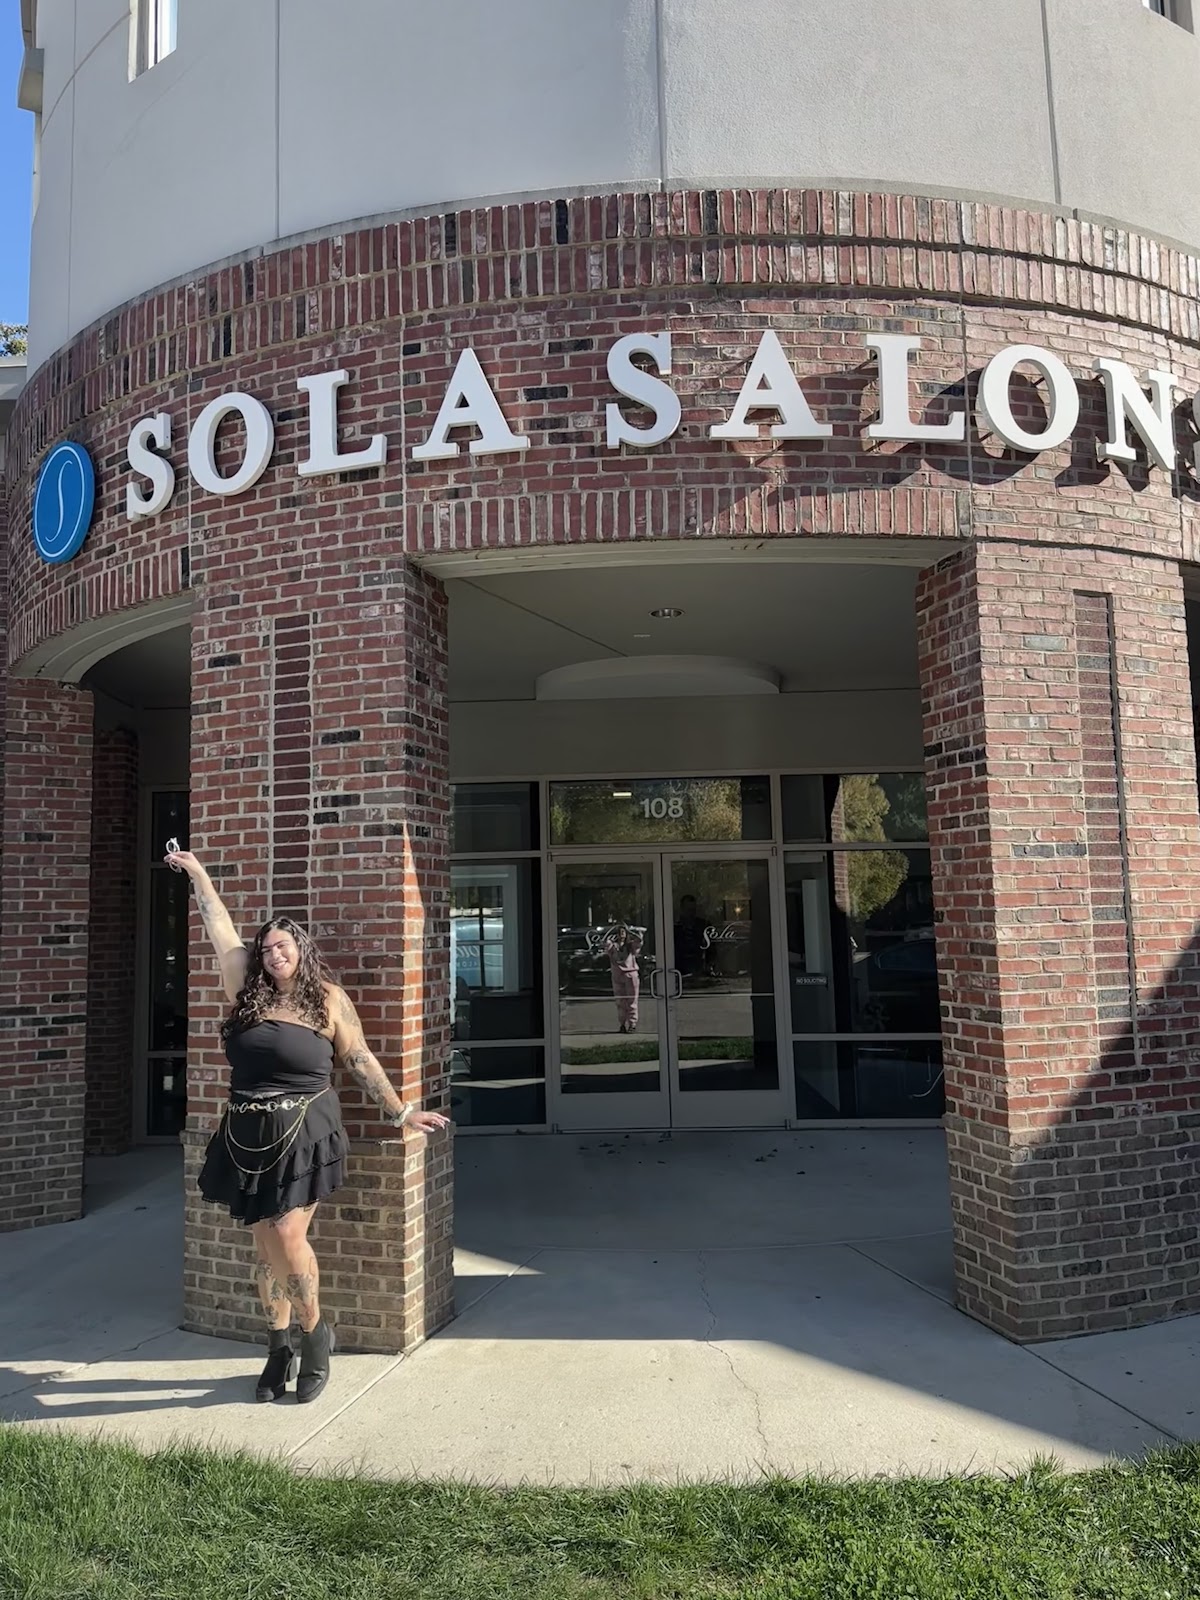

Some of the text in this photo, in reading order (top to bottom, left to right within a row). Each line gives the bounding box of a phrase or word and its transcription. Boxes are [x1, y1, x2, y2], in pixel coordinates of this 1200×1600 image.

[127, 329, 1200, 521] SOLA SALON
[641, 797, 684, 819] 108
[700, 921, 745, 950] Sola
